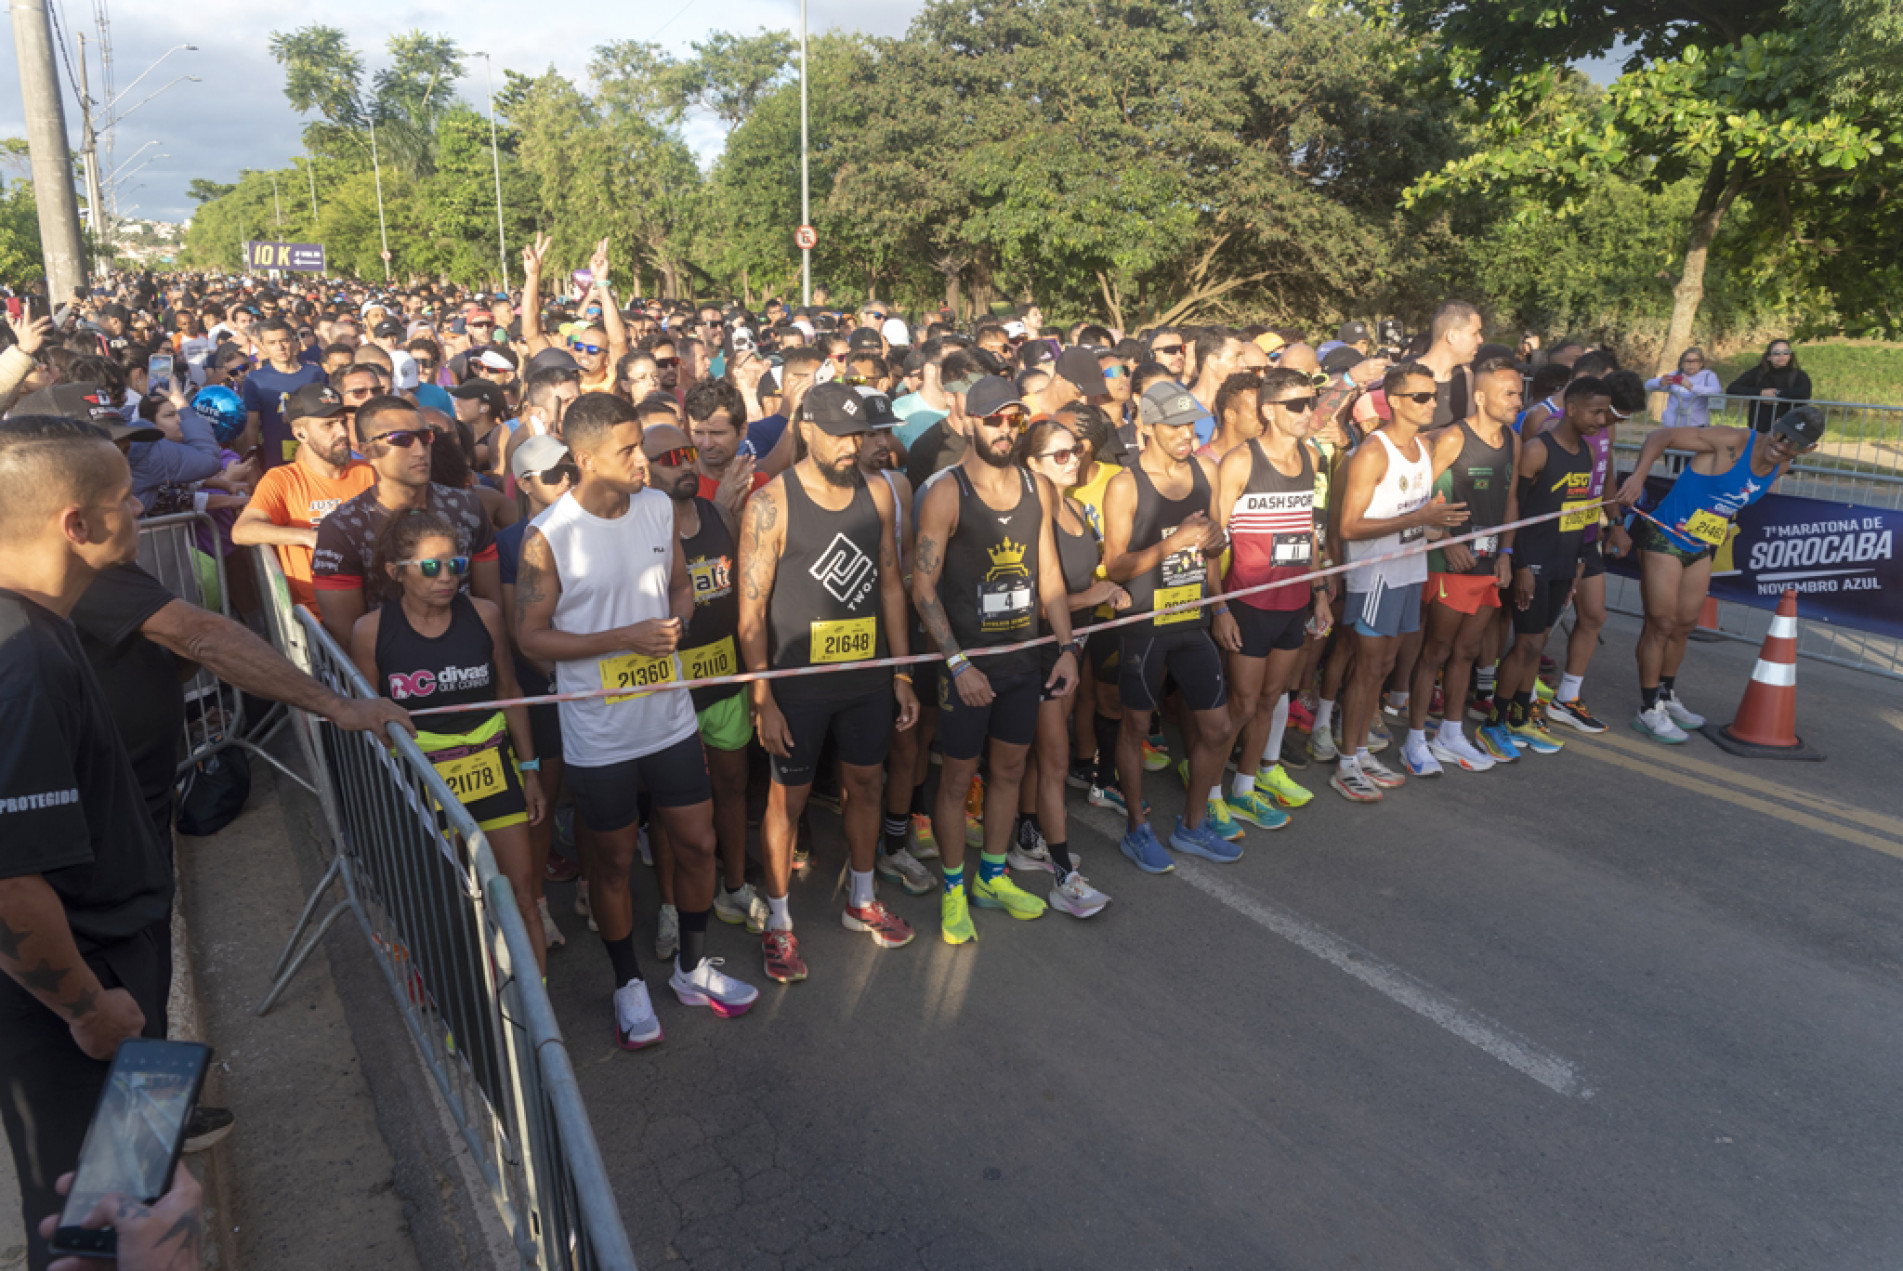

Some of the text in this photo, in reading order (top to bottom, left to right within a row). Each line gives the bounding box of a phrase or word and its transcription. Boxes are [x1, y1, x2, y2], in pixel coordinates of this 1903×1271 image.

[254, 244, 274, 265] 10
[277, 245, 292, 267] K
[1247, 496, 1286, 510] DASH
[1777, 519, 1860, 537] MARATONA
[1863, 516, 1883, 530] DE
[1749, 529, 1893, 570] SOROCABA
[1757, 576, 1882, 596] NOVEMBRO AZUL
[1004, 592, 1014, 609] 4
[825, 633, 869, 654] 21648
[438, 662, 490, 683] divas
[618, 660, 670, 688] 21360
[692, 653, 728, 679] 21110
[446, 767, 494, 795] 21178
